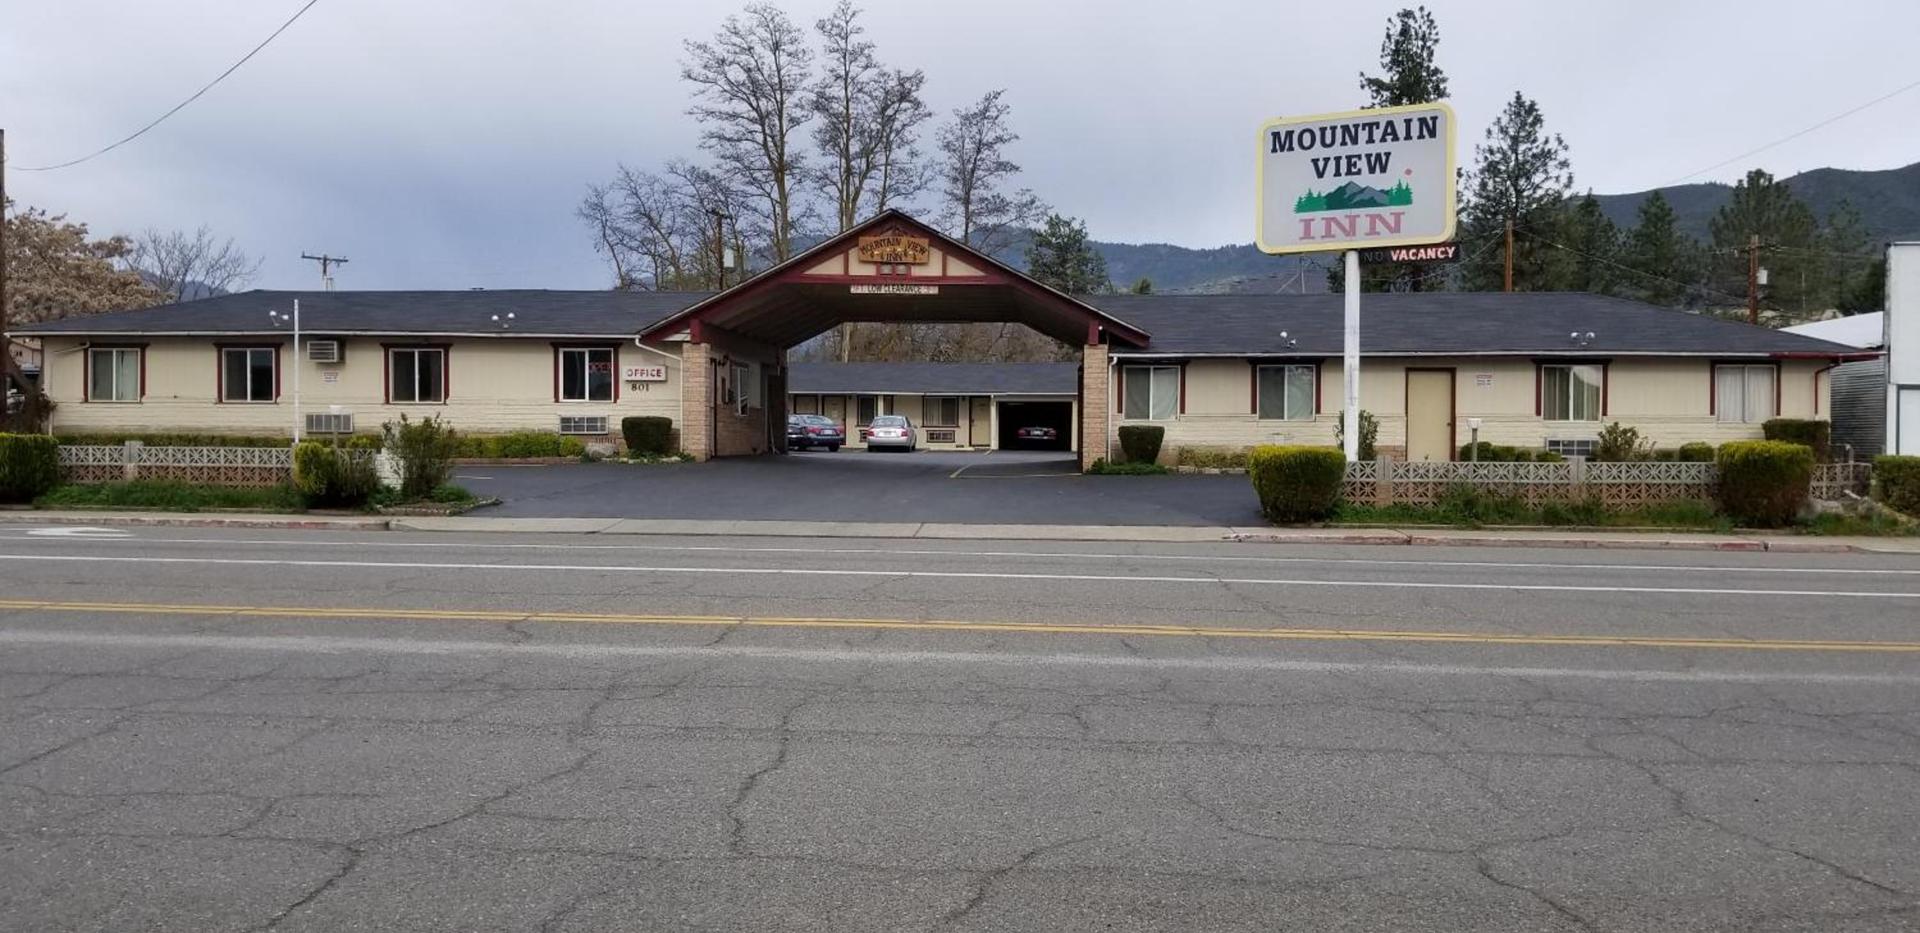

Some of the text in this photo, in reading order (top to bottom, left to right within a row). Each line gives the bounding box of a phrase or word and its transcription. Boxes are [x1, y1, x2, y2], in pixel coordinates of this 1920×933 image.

[1270, 116, 1439, 153] MOUNTAIN
[1311, 151, 1392, 179] VIEW
[1298, 212, 1406, 241] INN
[860, 237, 927, 256] MOUNTAIN VIEW
[1364, 246, 1456, 262] NO VACANCY
[886, 253, 902, 261] INN
[868, 285, 882, 294] LOW
[884, 285, 921, 294] CLEARANCE
[626, 368, 663, 378] OFFICE
[631, 383, 650, 392] 801
